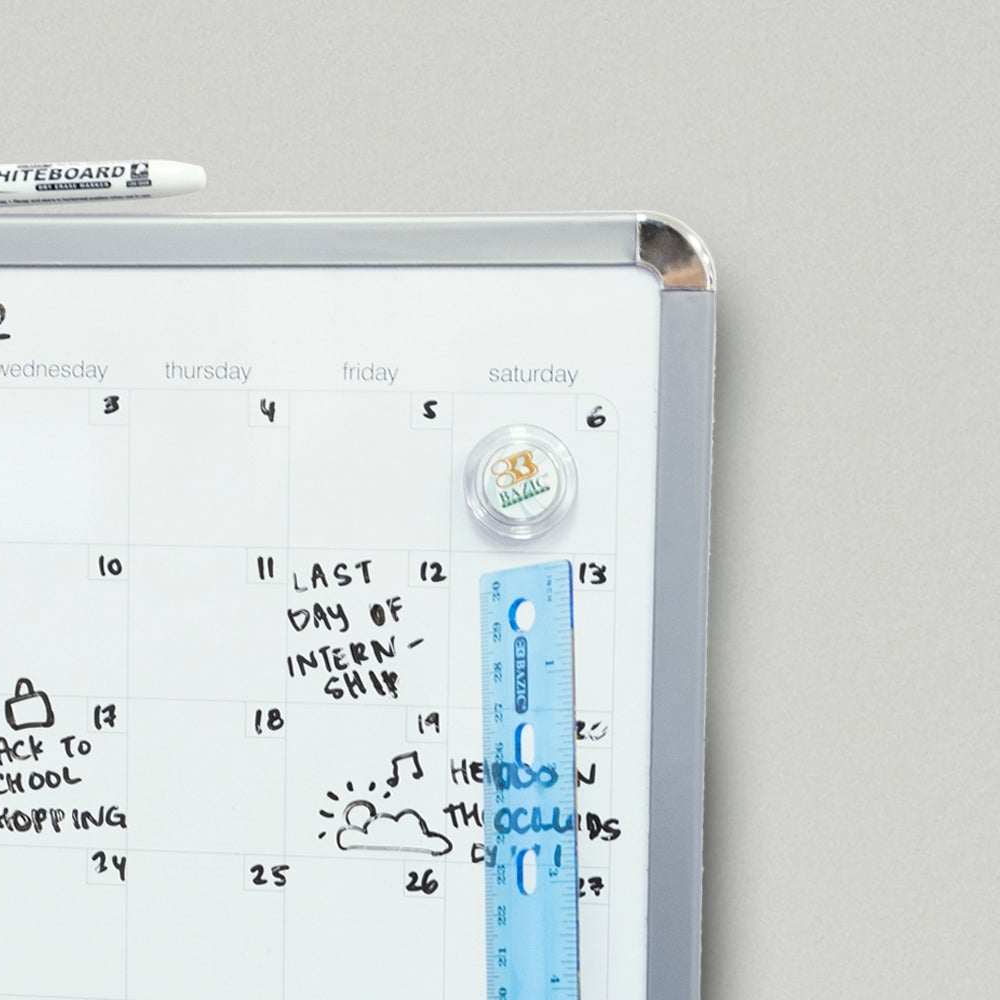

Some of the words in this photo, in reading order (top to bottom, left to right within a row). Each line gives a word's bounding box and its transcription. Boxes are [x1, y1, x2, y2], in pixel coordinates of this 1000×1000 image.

[164, 360, 253, 385] thursday
[343, 361, 399, 386] friday
[488, 363, 579, 388] saturday
[103, 395, 120, 415] 3
[260, 398, 276, 423] 4
[423, 400, 438, 420] 5
[586, 405, 607, 429] 6
[98, 555, 123, 577] 10
[257, 556, 274, 581] 11
[293, 559, 372, 592] LAST
[420, 561, 447, 583] 12
[578, 562, 607, 585] 13
[286, 602, 350, 633] DAY
[369, 596, 403, 627] OF
[93, 703, 117, 731] 17
[254, 708, 285, 735] 18
[417, 712, 440, 735] 19
[59, 735, 92, 759] TO
[91, 851, 127, 882] 24
[250, 864, 290, 887] 25
[405, 868, 439, 895] 26
[498, 948, 507, 967] 21
